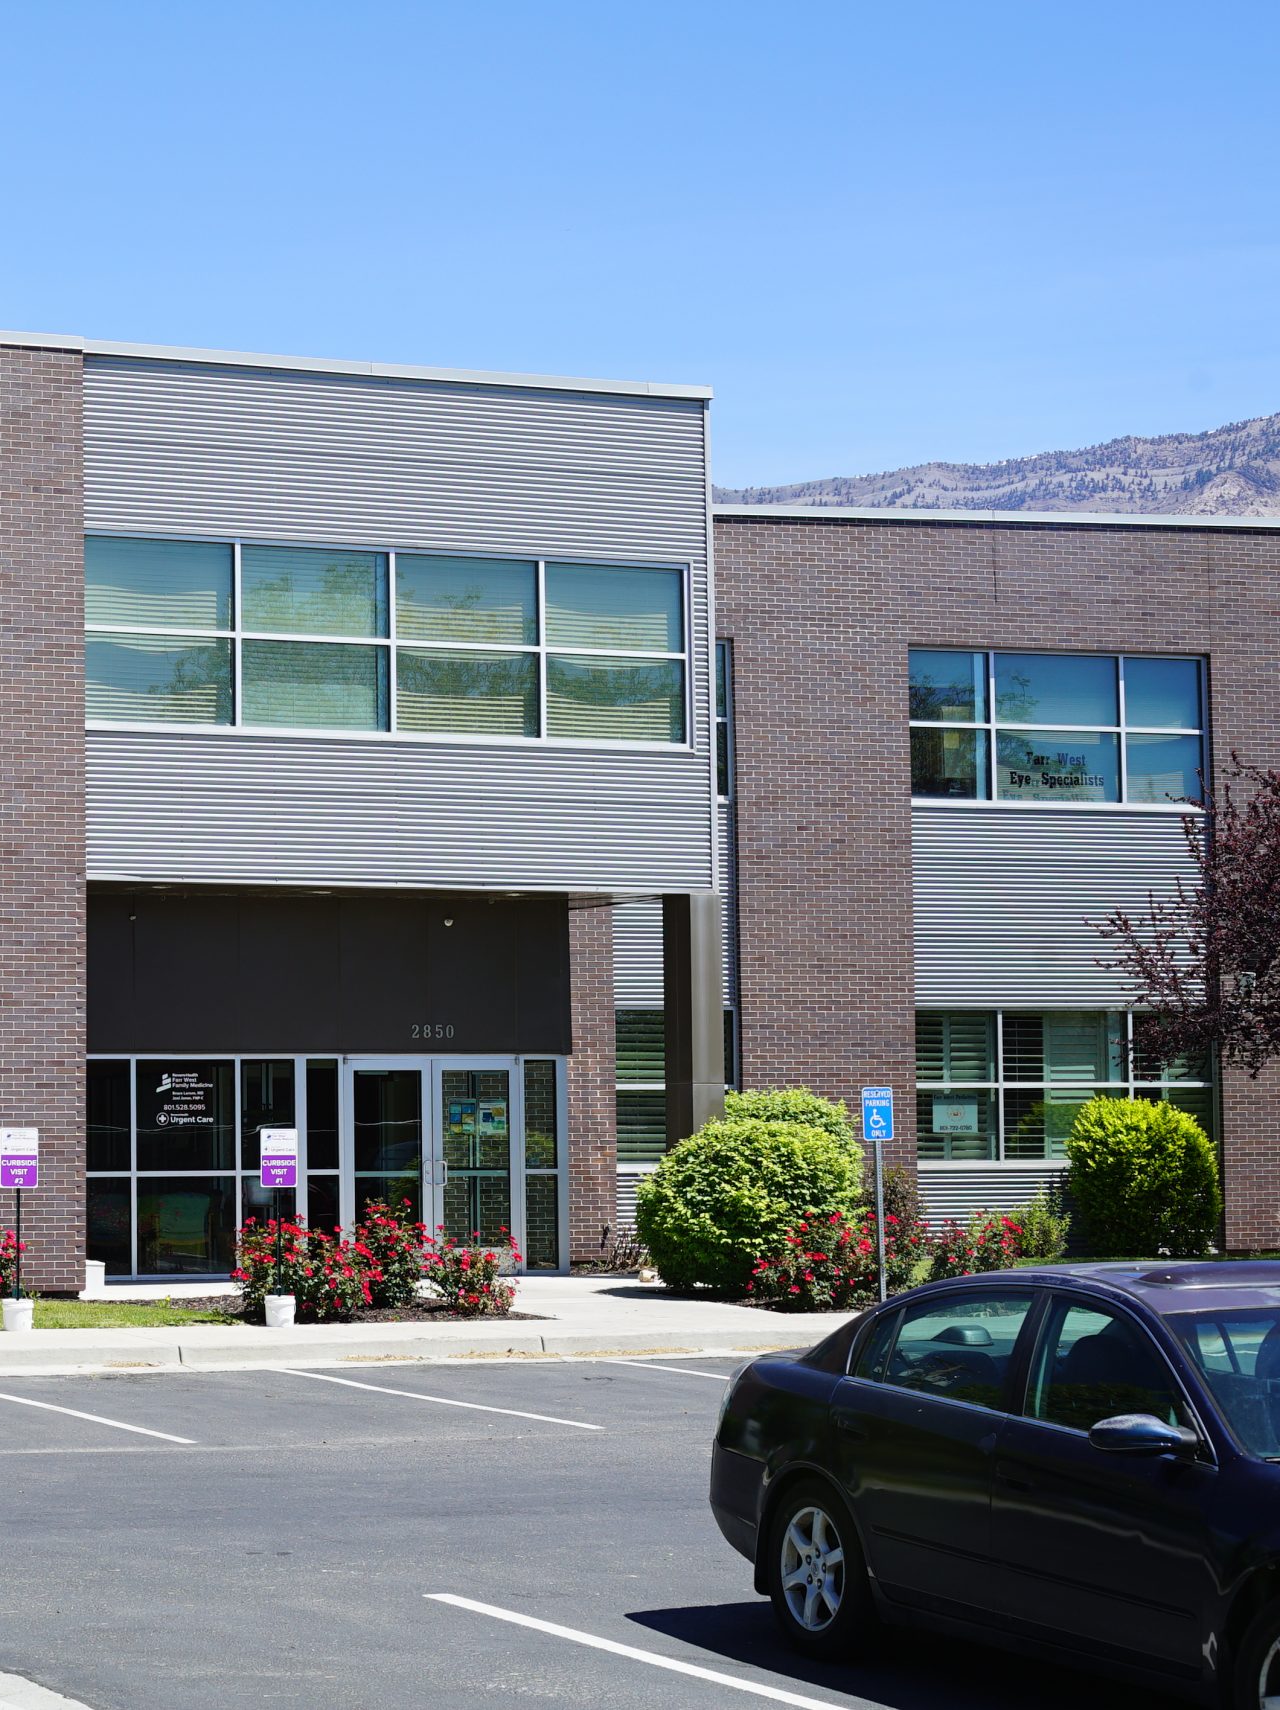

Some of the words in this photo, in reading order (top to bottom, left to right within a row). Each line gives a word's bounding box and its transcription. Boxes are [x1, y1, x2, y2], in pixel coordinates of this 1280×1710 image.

[1026, 751, 1050, 766] Farr
[1057, 752, 1087, 766] West
[1009, 771, 1031, 788] Eye
[1041, 771, 1104, 789] Specialists
[411, 1024, 455, 1039] 2850
[863, 1090, 891, 1098] RESERVED
[865, 1099, 890, 1107] PARKING
[170, 1116, 195, 1124] Urgent
[871, 1129, 887, 1137] ONLY
